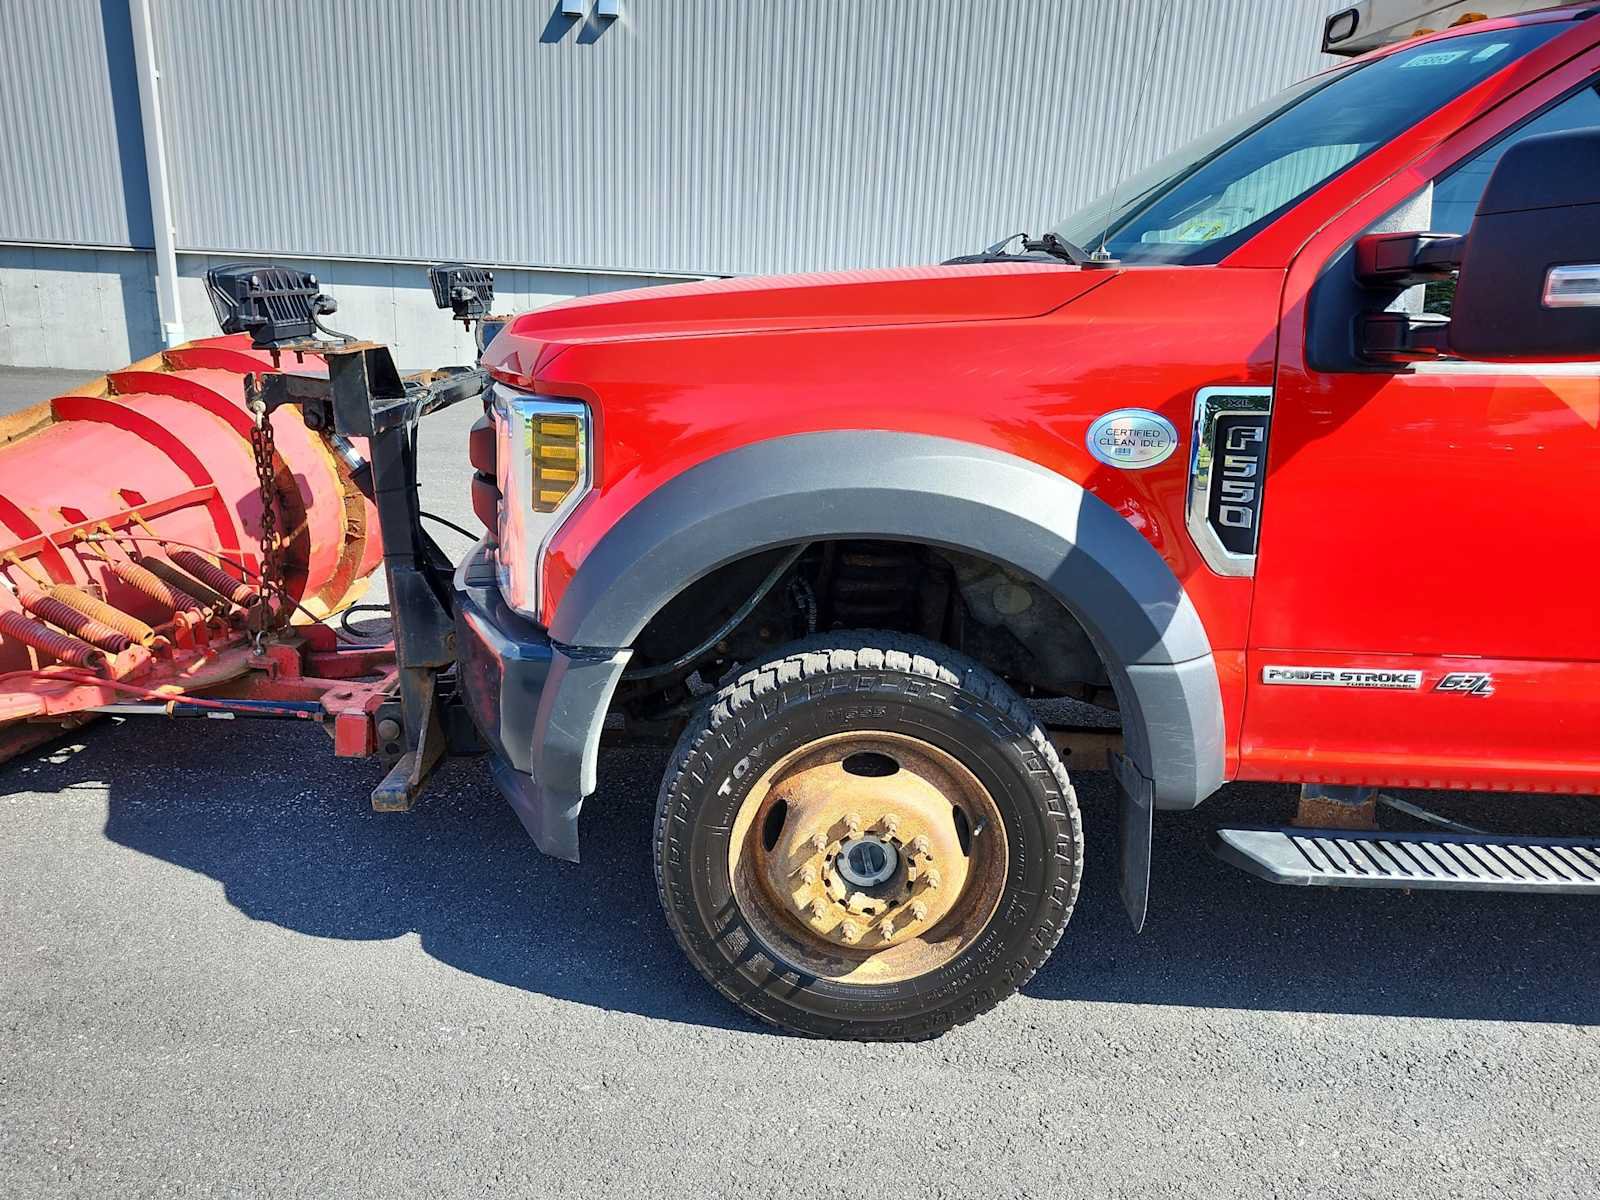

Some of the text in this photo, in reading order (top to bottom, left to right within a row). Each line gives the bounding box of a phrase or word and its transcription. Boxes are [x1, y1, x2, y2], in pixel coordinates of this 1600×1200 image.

[1105, 428, 1161, 438] CERTIFIED
[1099, 438, 1165, 448] CLEAN IDLE
[1218, 425, 1265, 529] F550
[1268, 668, 1417, 684] POWER STROKE
